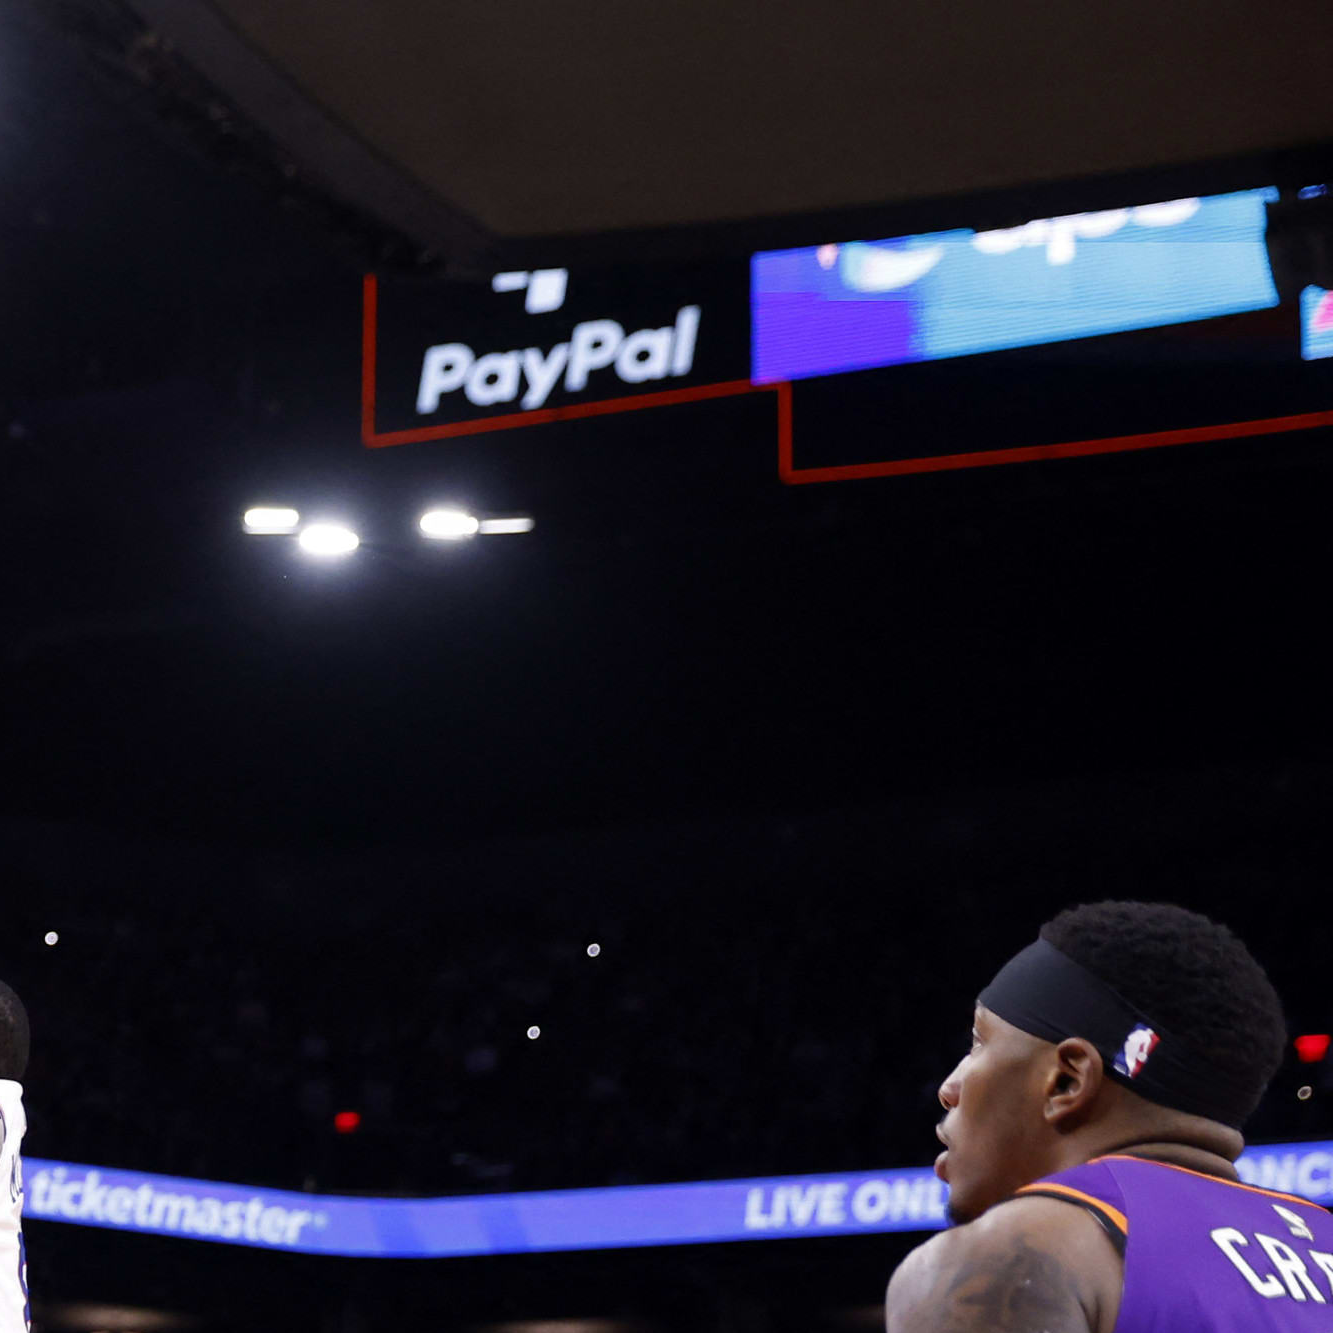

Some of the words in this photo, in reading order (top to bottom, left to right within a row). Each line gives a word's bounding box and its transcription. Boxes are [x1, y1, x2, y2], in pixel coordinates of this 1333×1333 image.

[416, 305, 701, 414] PayPal
[30, 1166, 312, 1245] ticketmaster
[744, 1182, 848, 1230] LIVE
[851, 1178, 945, 1224] ONL
